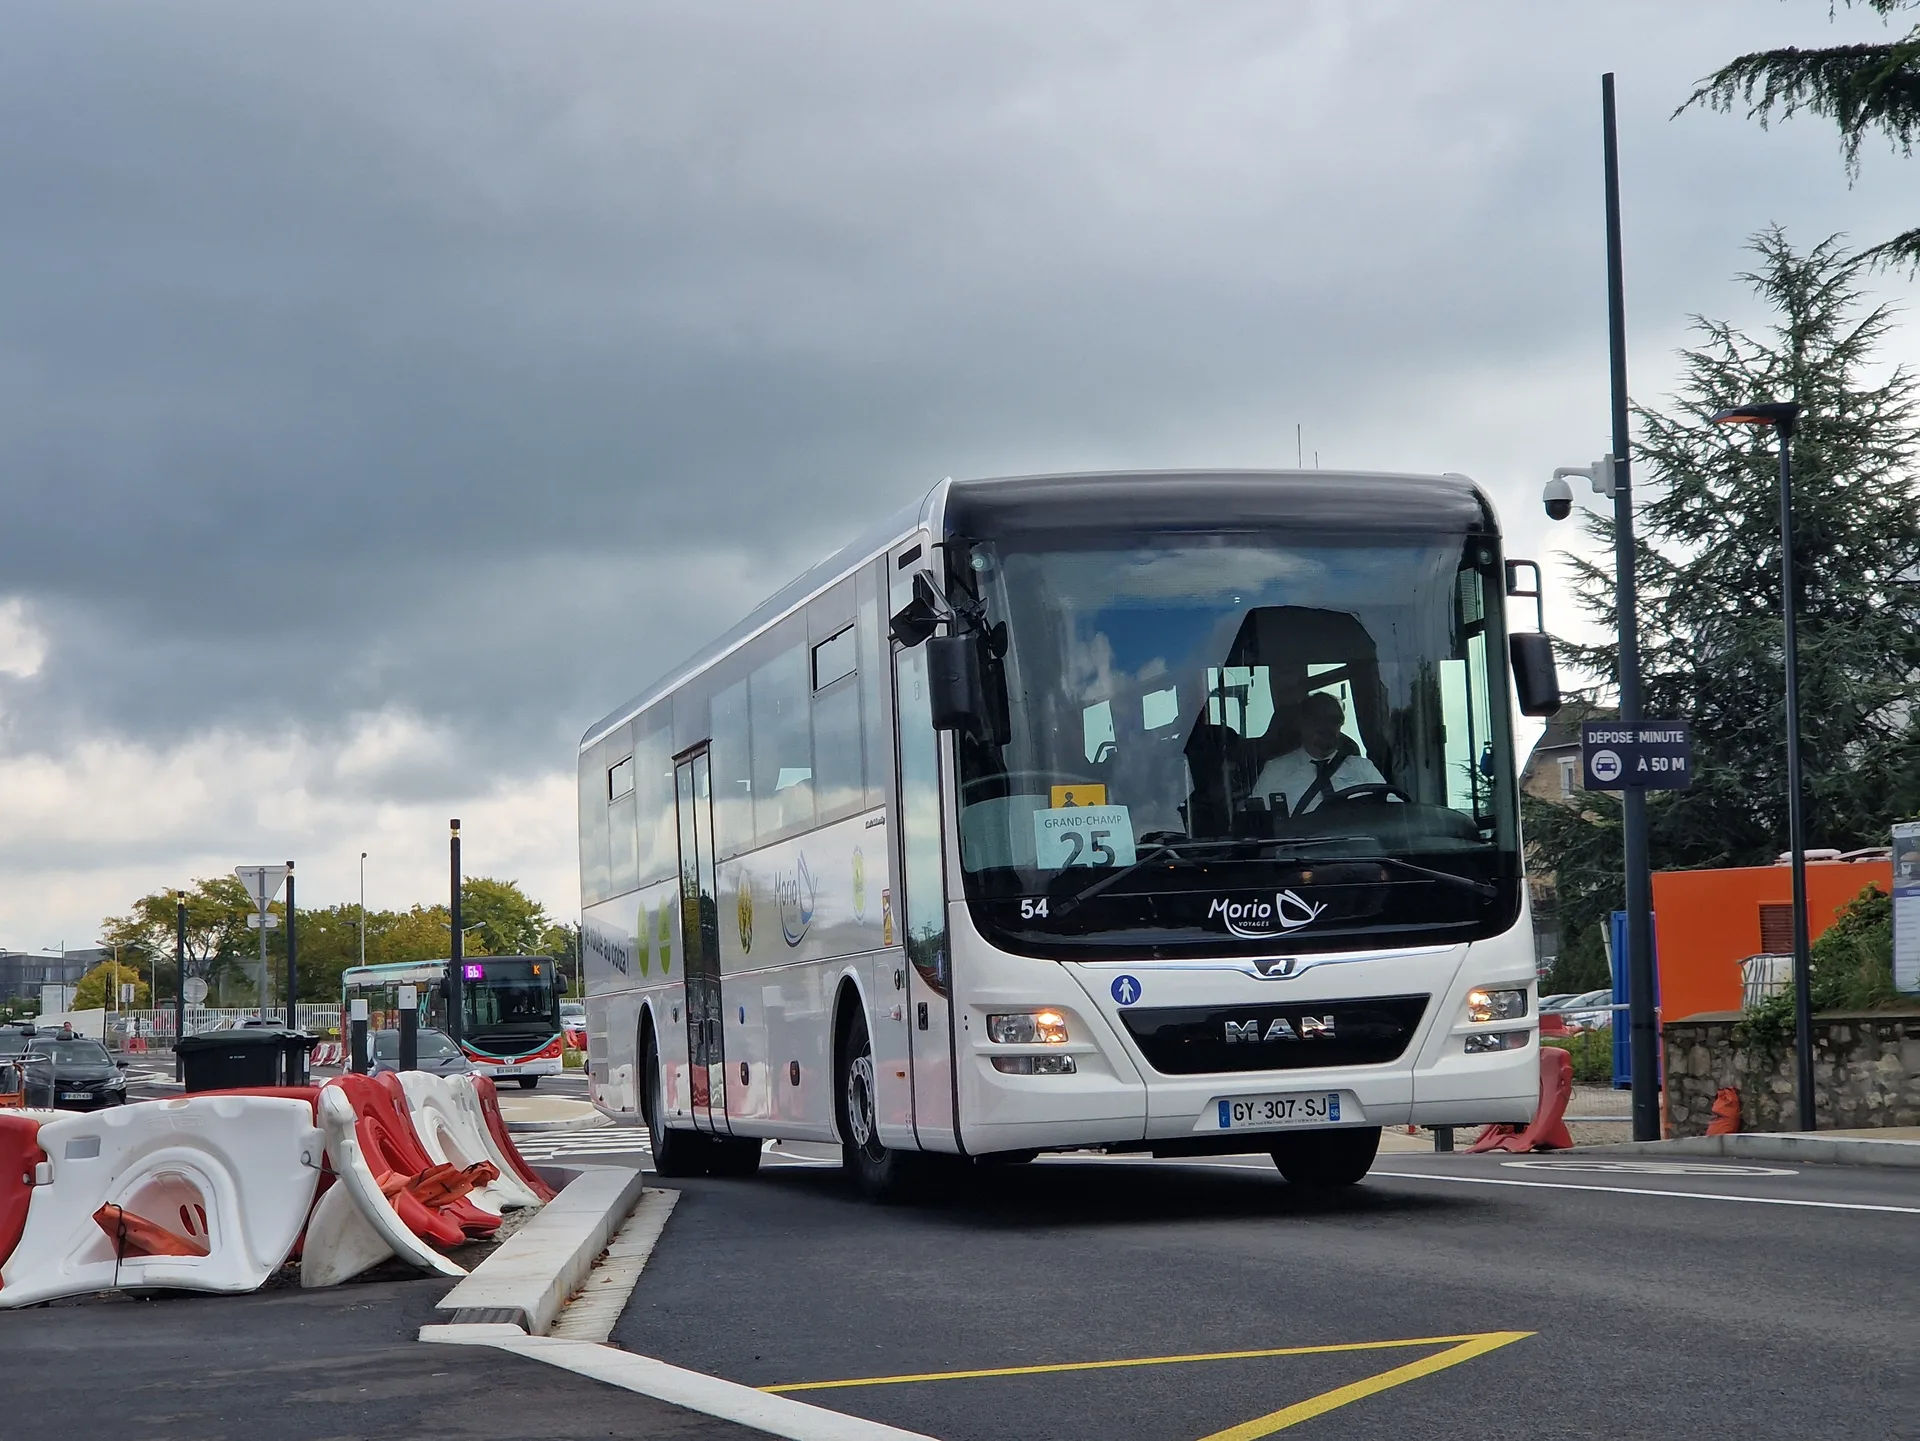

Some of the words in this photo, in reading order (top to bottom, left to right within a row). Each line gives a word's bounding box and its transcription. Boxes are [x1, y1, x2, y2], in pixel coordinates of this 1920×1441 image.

[1588, 729, 1684, 744] DÉPOSE-MINUTE
[1637, 755, 1648, 771] À
[1651, 757, 1668, 771] 50
[1671, 757, 1685, 771] M
[1044, 815, 1122, 829] GRAND-CHAMP
[1060, 830, 1115, 868] 25
[774, 870, 797, 907] Morio
[1020, 898, 1049, 919] 54
[1208, 899, 1271, 919] Morio
[533, 965, 540, 975] K
[1225, 1015, 1336, 1043] MAN
[1233, 1098, 1327, 1121] GY-307-SJ
[1330, 1108, 1339, 1118] 56
